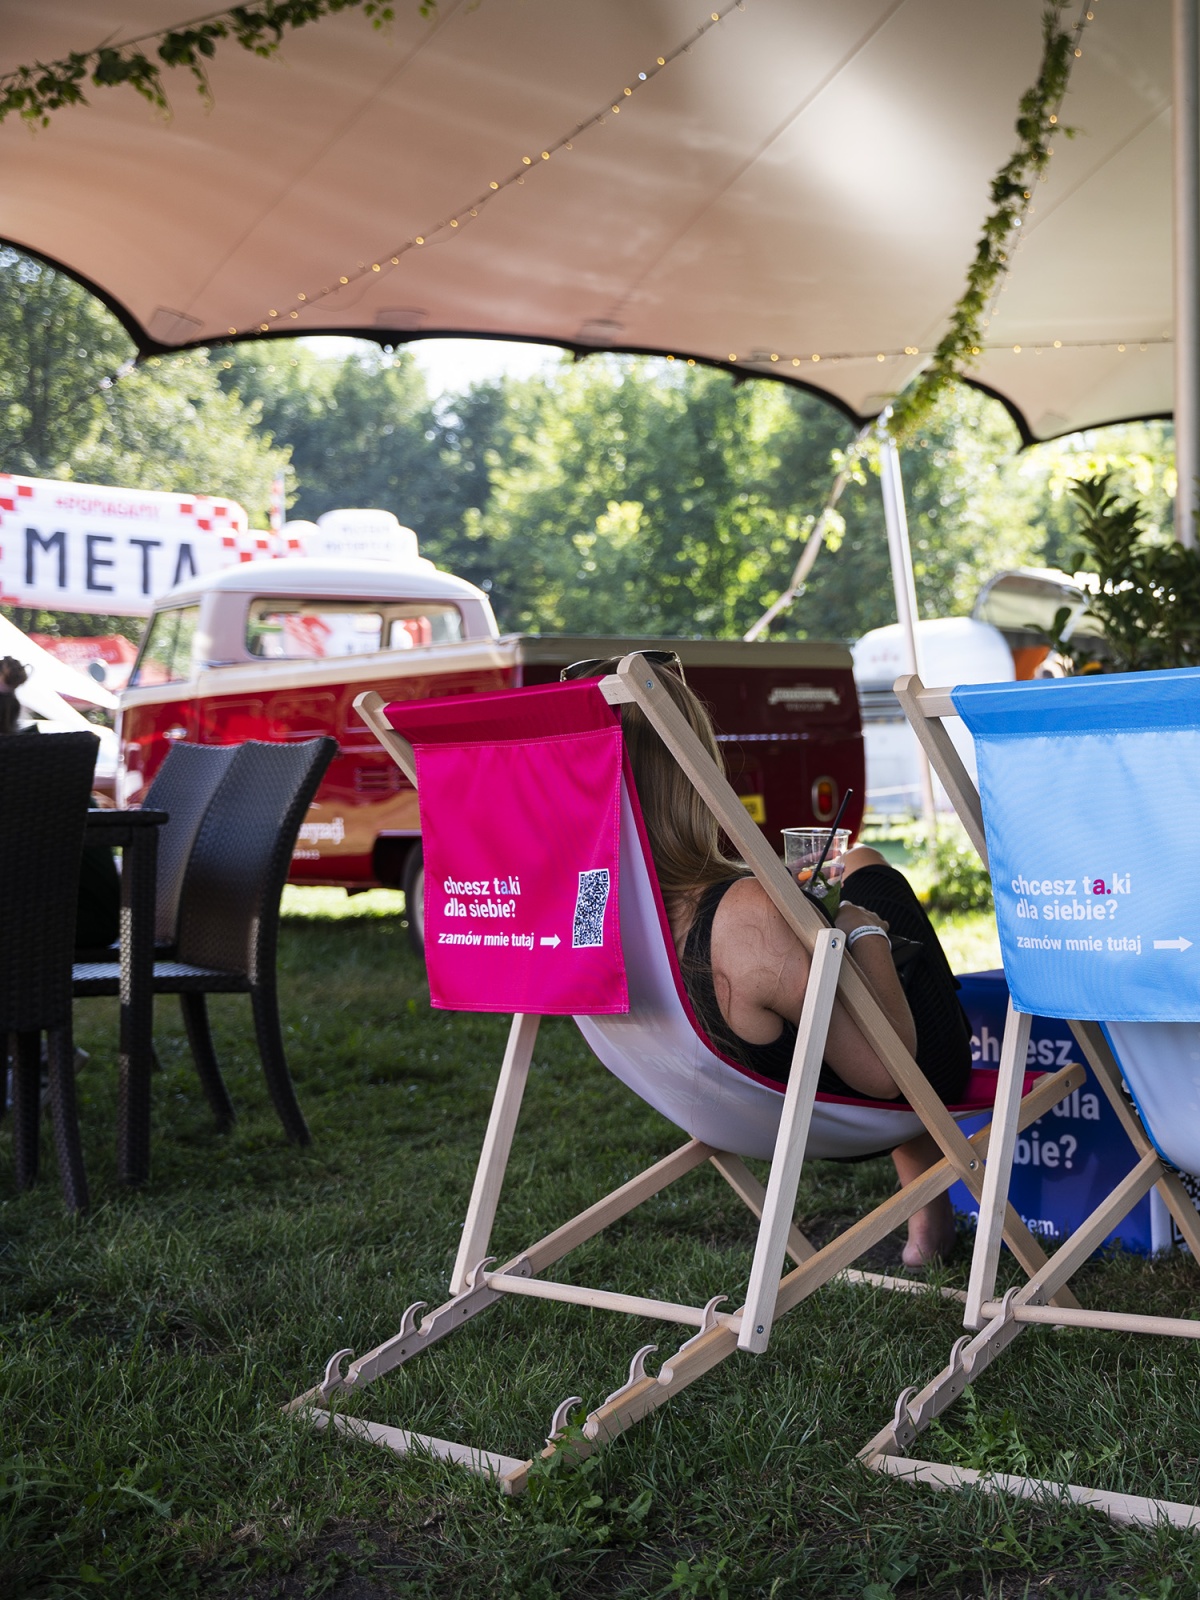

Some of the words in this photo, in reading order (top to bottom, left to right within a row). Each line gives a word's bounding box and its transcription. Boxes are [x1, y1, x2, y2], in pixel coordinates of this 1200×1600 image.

[25, 527, 197, 594] META
[443, 875, 490, 896] chcesz
[493, 875, 521, 896] ta.ki
[1011, 873, 1077, 896] chcesz
[1082, 873, 1132, 895] ta.ki
[443, 898, 467, 917] dla
[469, 898, 516, 918] siebie?
[1016, 898, 1039, 920] dla
[1043, 899, 1118, 921] siebie?
[437, 930, 482, 946] zamów
[483, 931, 510, 947] mnie
[511, 932, 535, 951] tutaj
[1016, 934, 1062, 950] zamów
[1065, 936, 1103, 951] mnie
[1106, 935, 1142, 955] tutaj
[969, 1026, 1073, 1066] chesz
[1013, 1130, 1078, 1169] bie?
